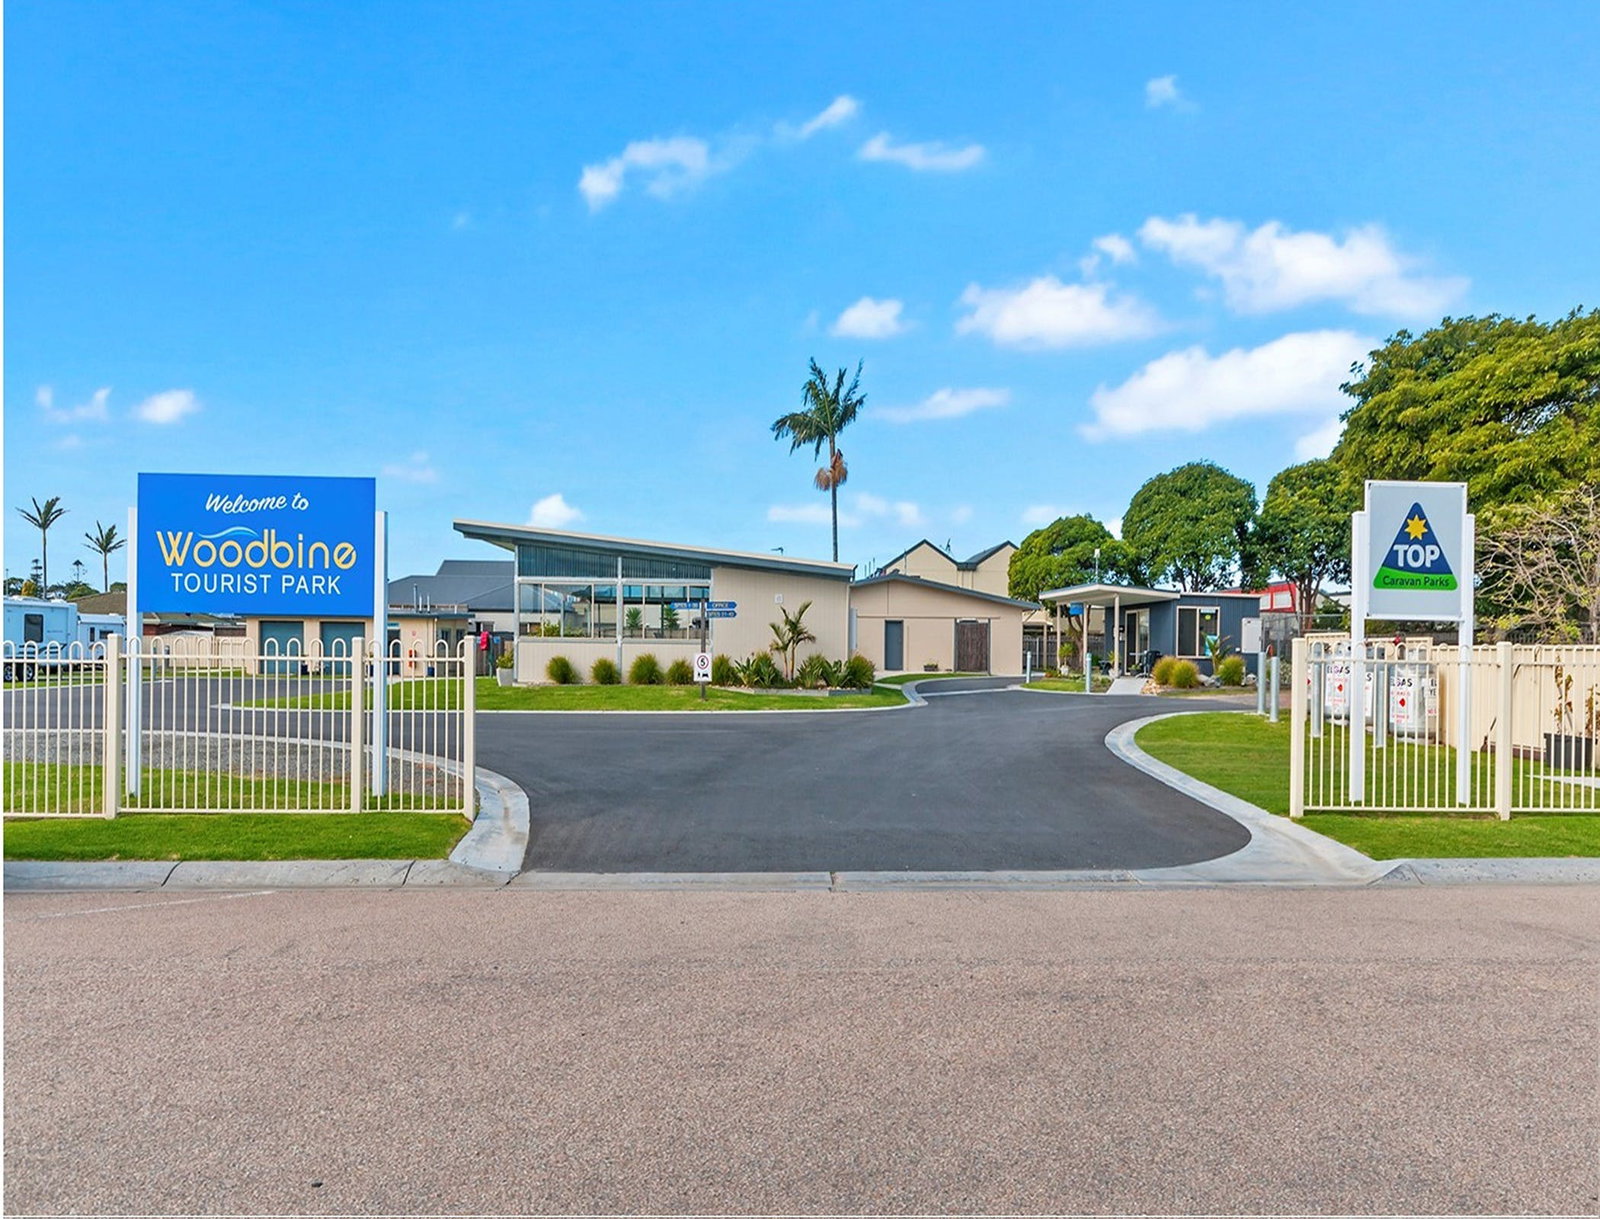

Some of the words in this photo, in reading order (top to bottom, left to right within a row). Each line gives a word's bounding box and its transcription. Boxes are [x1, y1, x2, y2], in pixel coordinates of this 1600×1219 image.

[205, 493, 287, 514] Welcome
[292, 492, 309, 511] to
[156, 529, 357, 569] Woodbine
[1393, 544, 1440, 568] TOP
[171, 573, 272, 594] TOURIST
[282, 575, 341, 595] PARK
[1382, 575, 1421, 586] Caravan
[1424, 576, 1450, 587] Parks
[700, 657, 706, 667] 5
